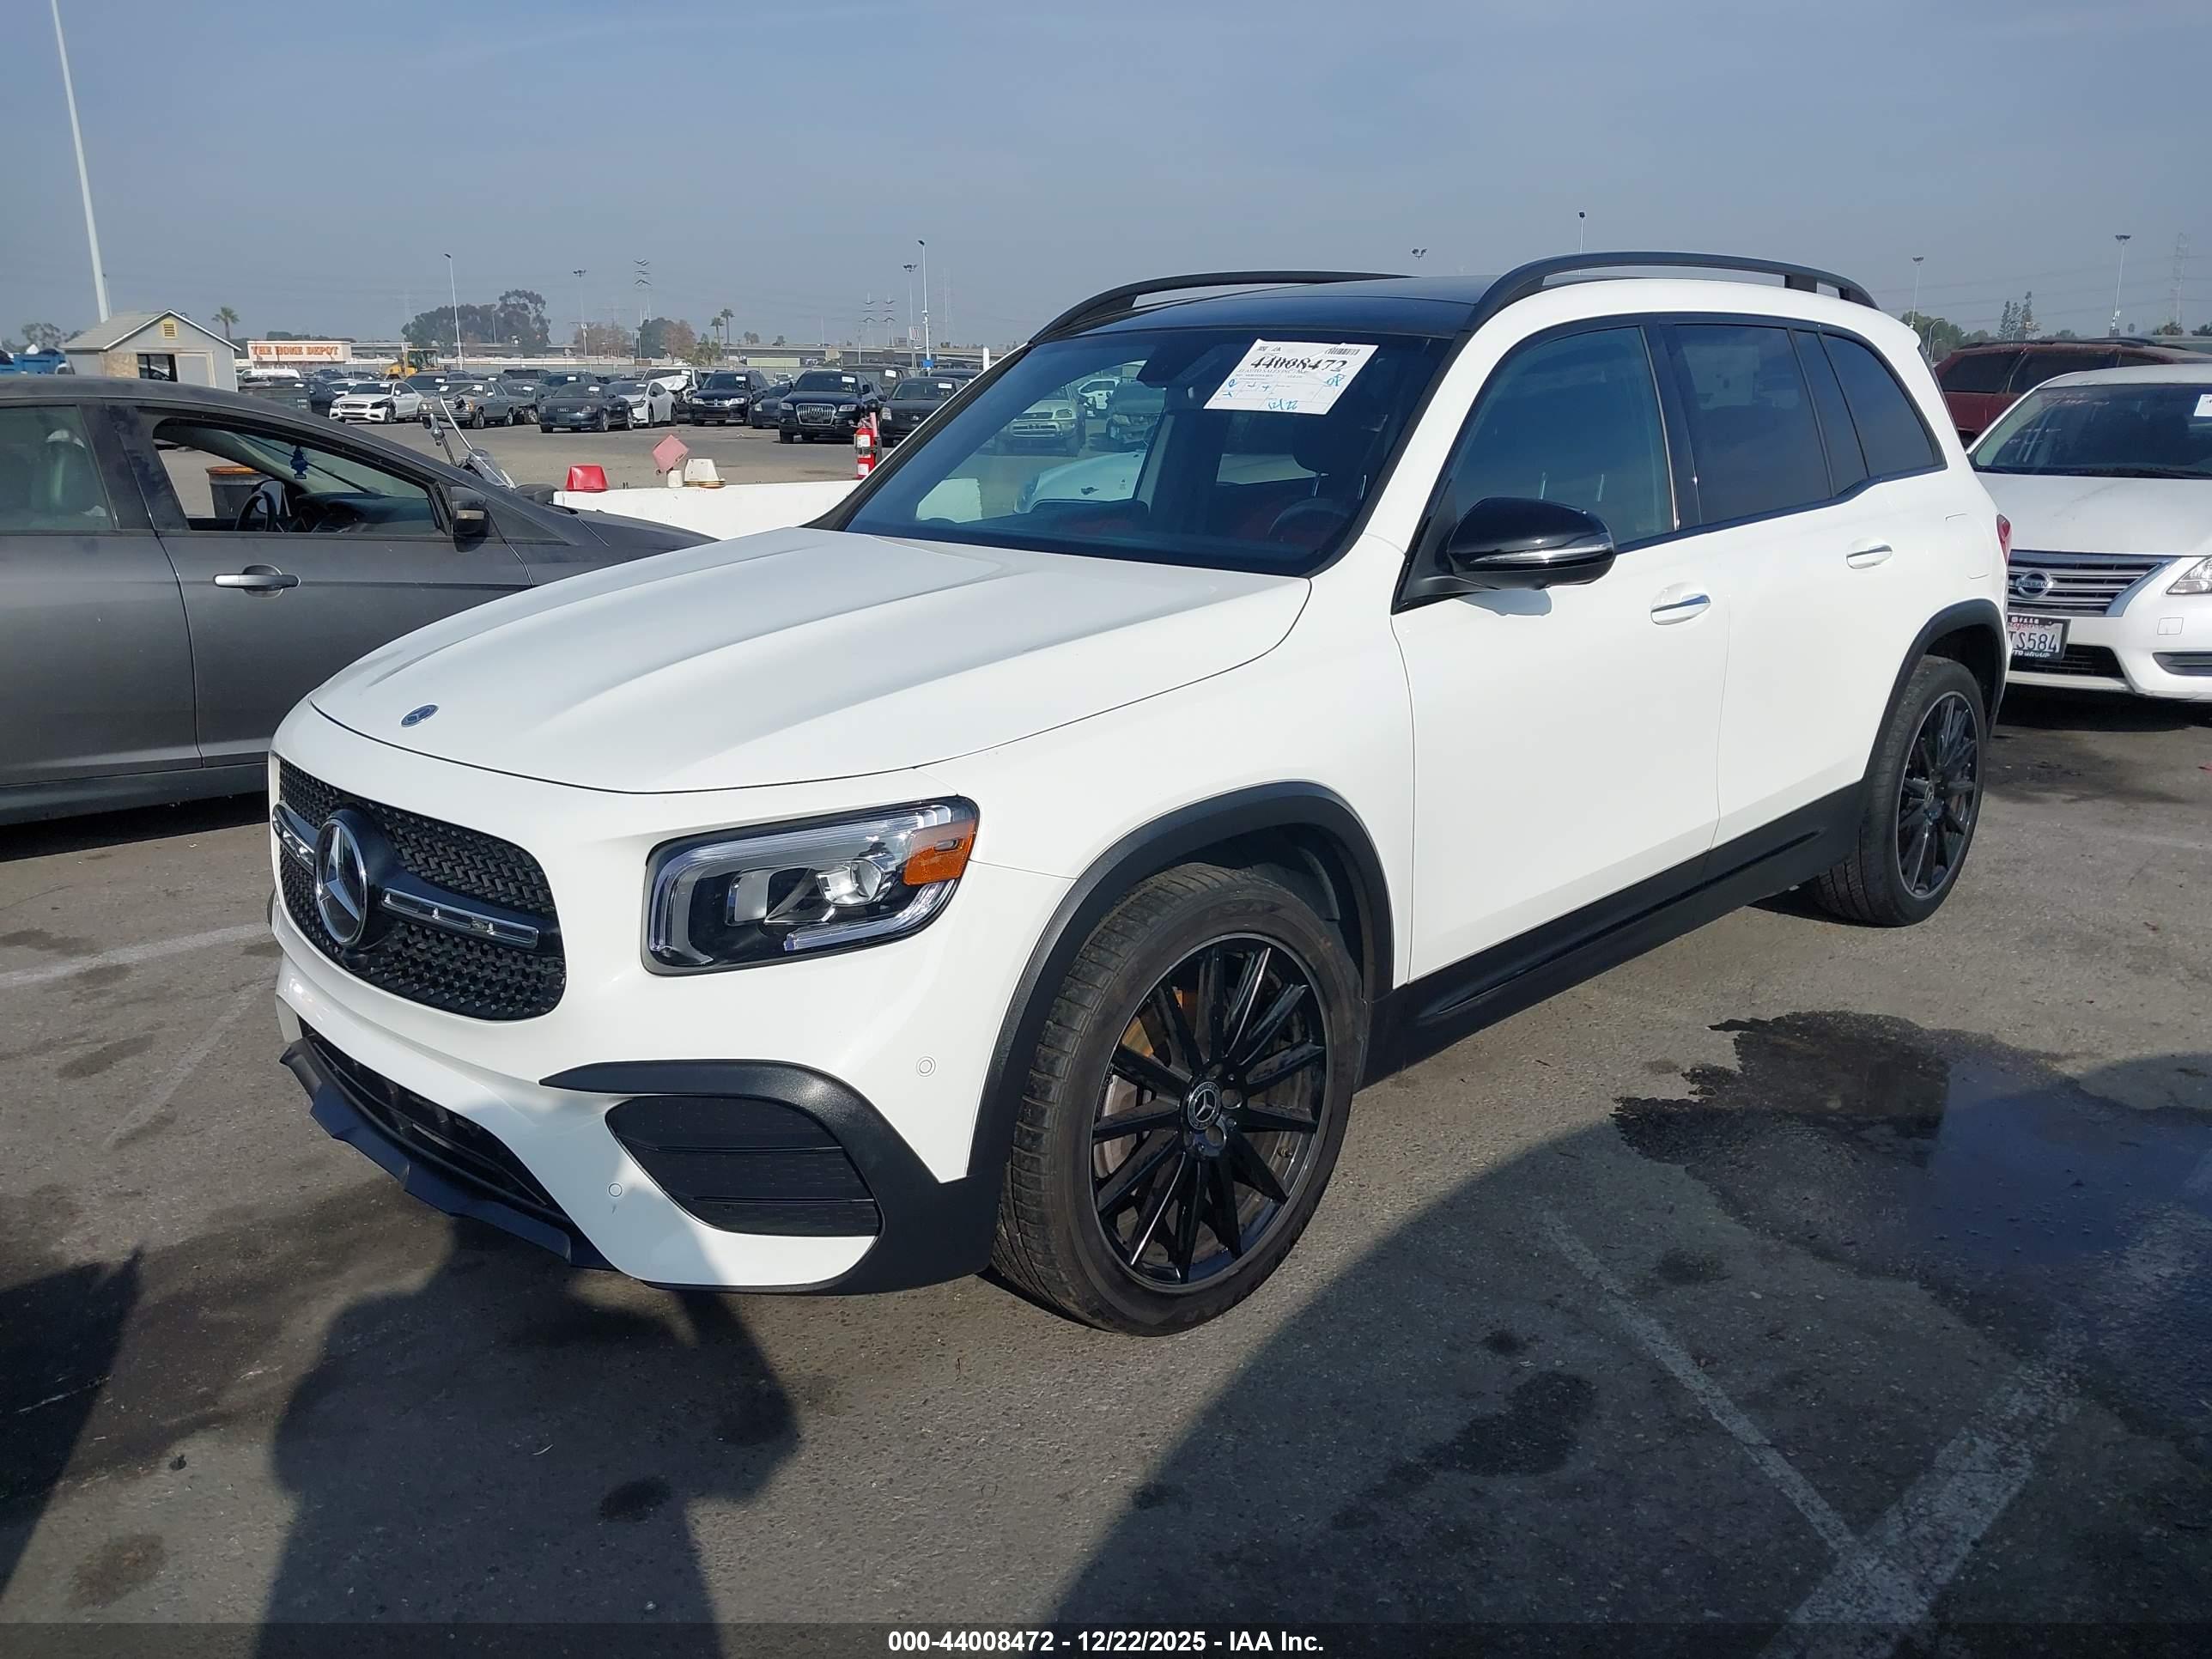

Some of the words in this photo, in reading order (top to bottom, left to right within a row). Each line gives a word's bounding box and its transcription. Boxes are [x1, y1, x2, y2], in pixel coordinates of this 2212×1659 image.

[252, 345, 272, 356] THE
[276, 345, 303, 356] HOME
[306, 345, 339, 356] DEPOT
[1250, 356, 1348, 373] 44008472
[2019, 580, 2049, 588] NISSAN
